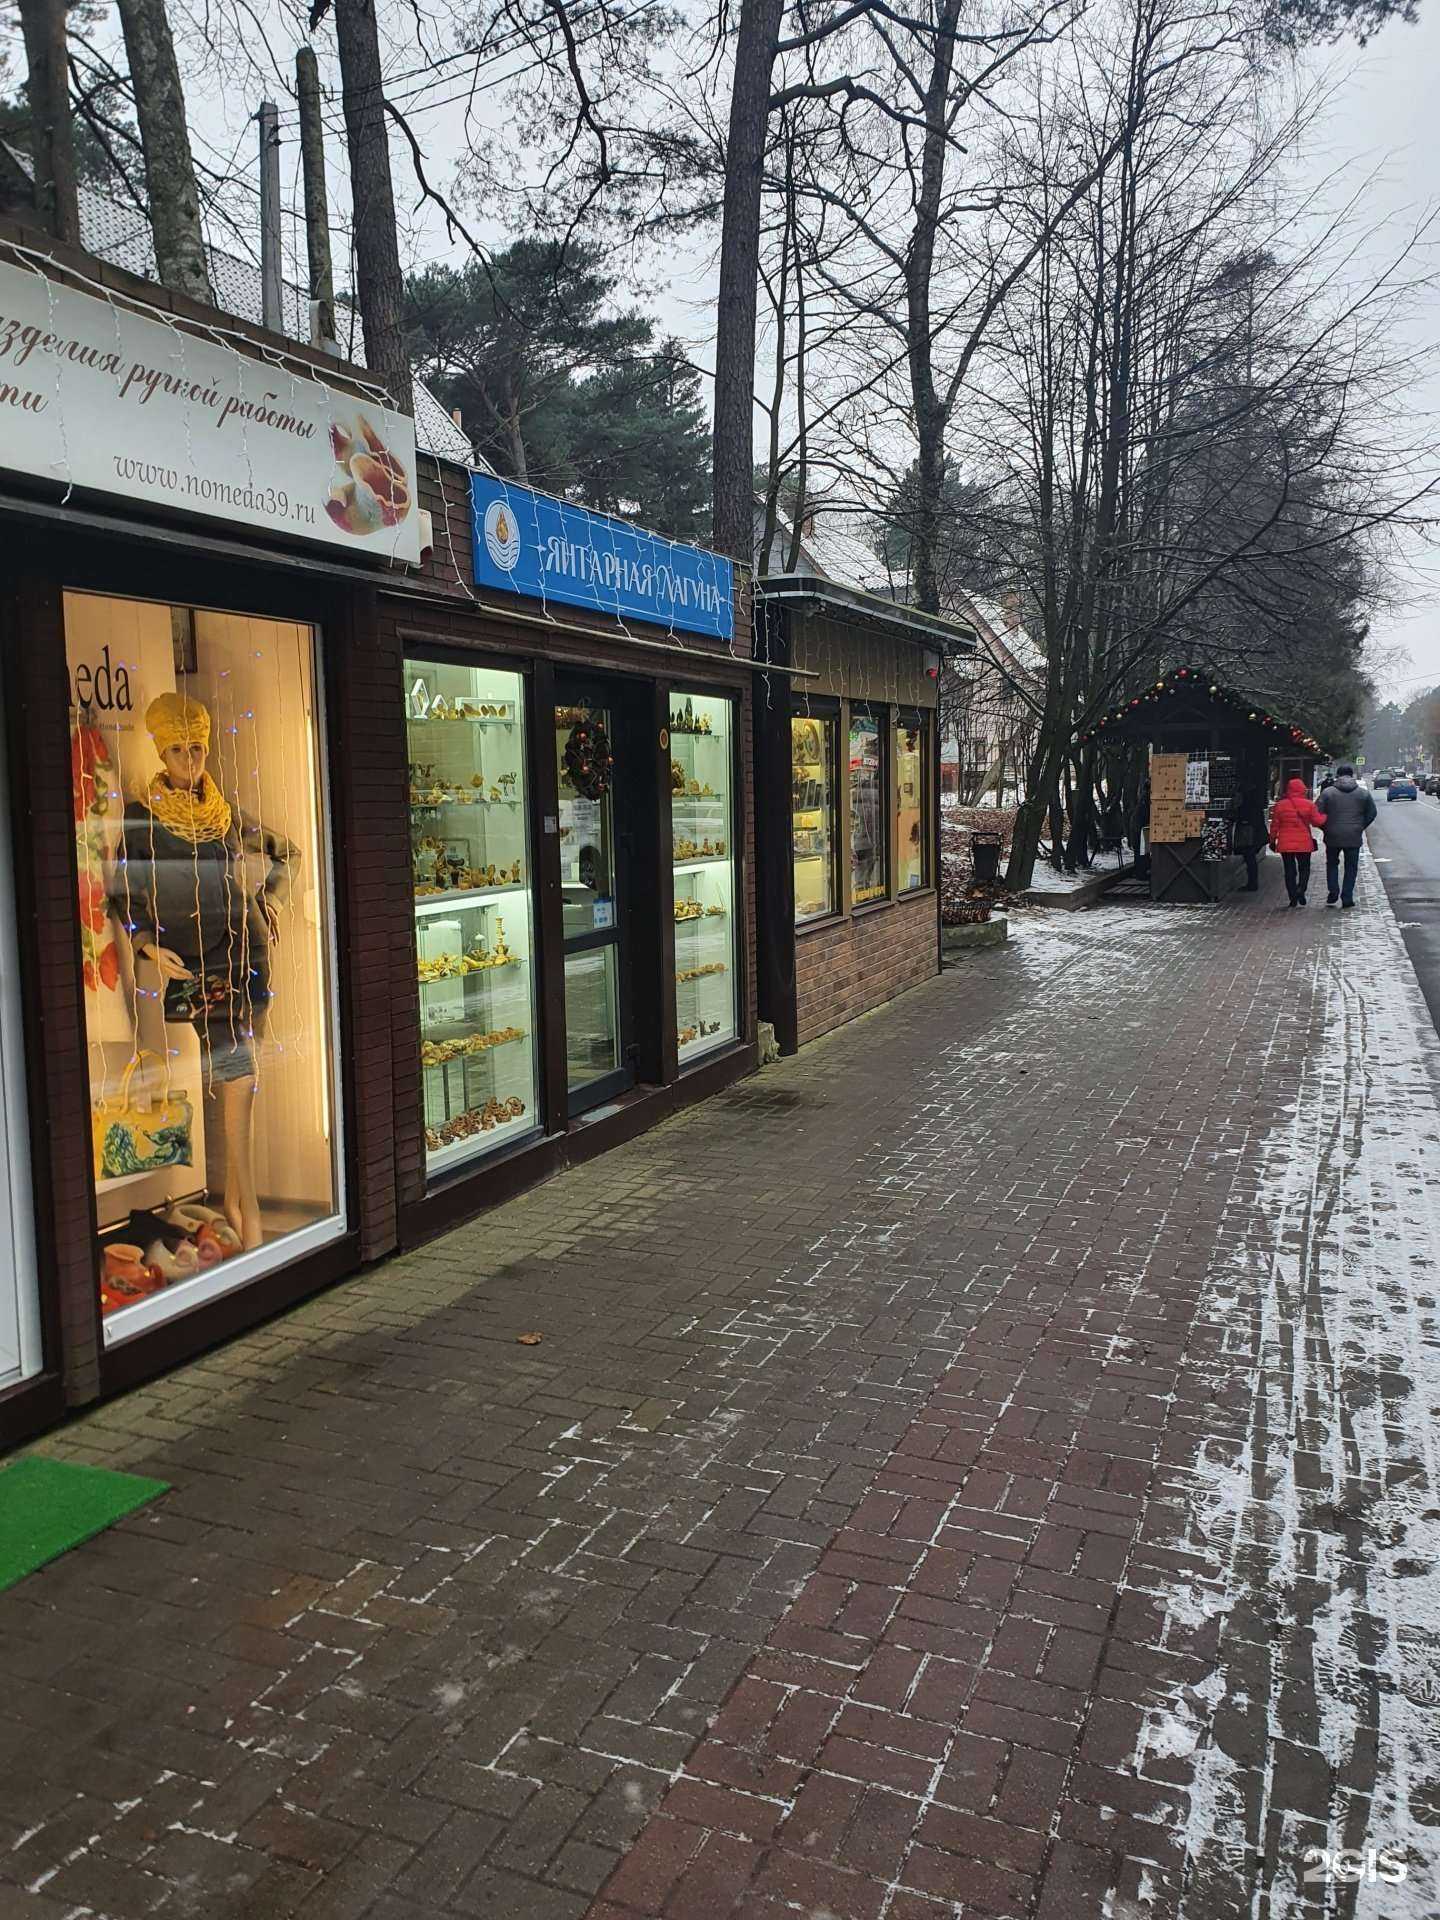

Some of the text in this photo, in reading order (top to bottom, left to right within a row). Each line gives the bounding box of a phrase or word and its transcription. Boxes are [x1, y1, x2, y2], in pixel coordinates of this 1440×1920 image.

[119, 363, 223, 405] ручной
[216, 392, 318, 439] работы
[113, 456, 316, 524] www.nomeda39.ru
[546, 536, 720, 614] ЯНТАРНАЯ ЛАГУНА
